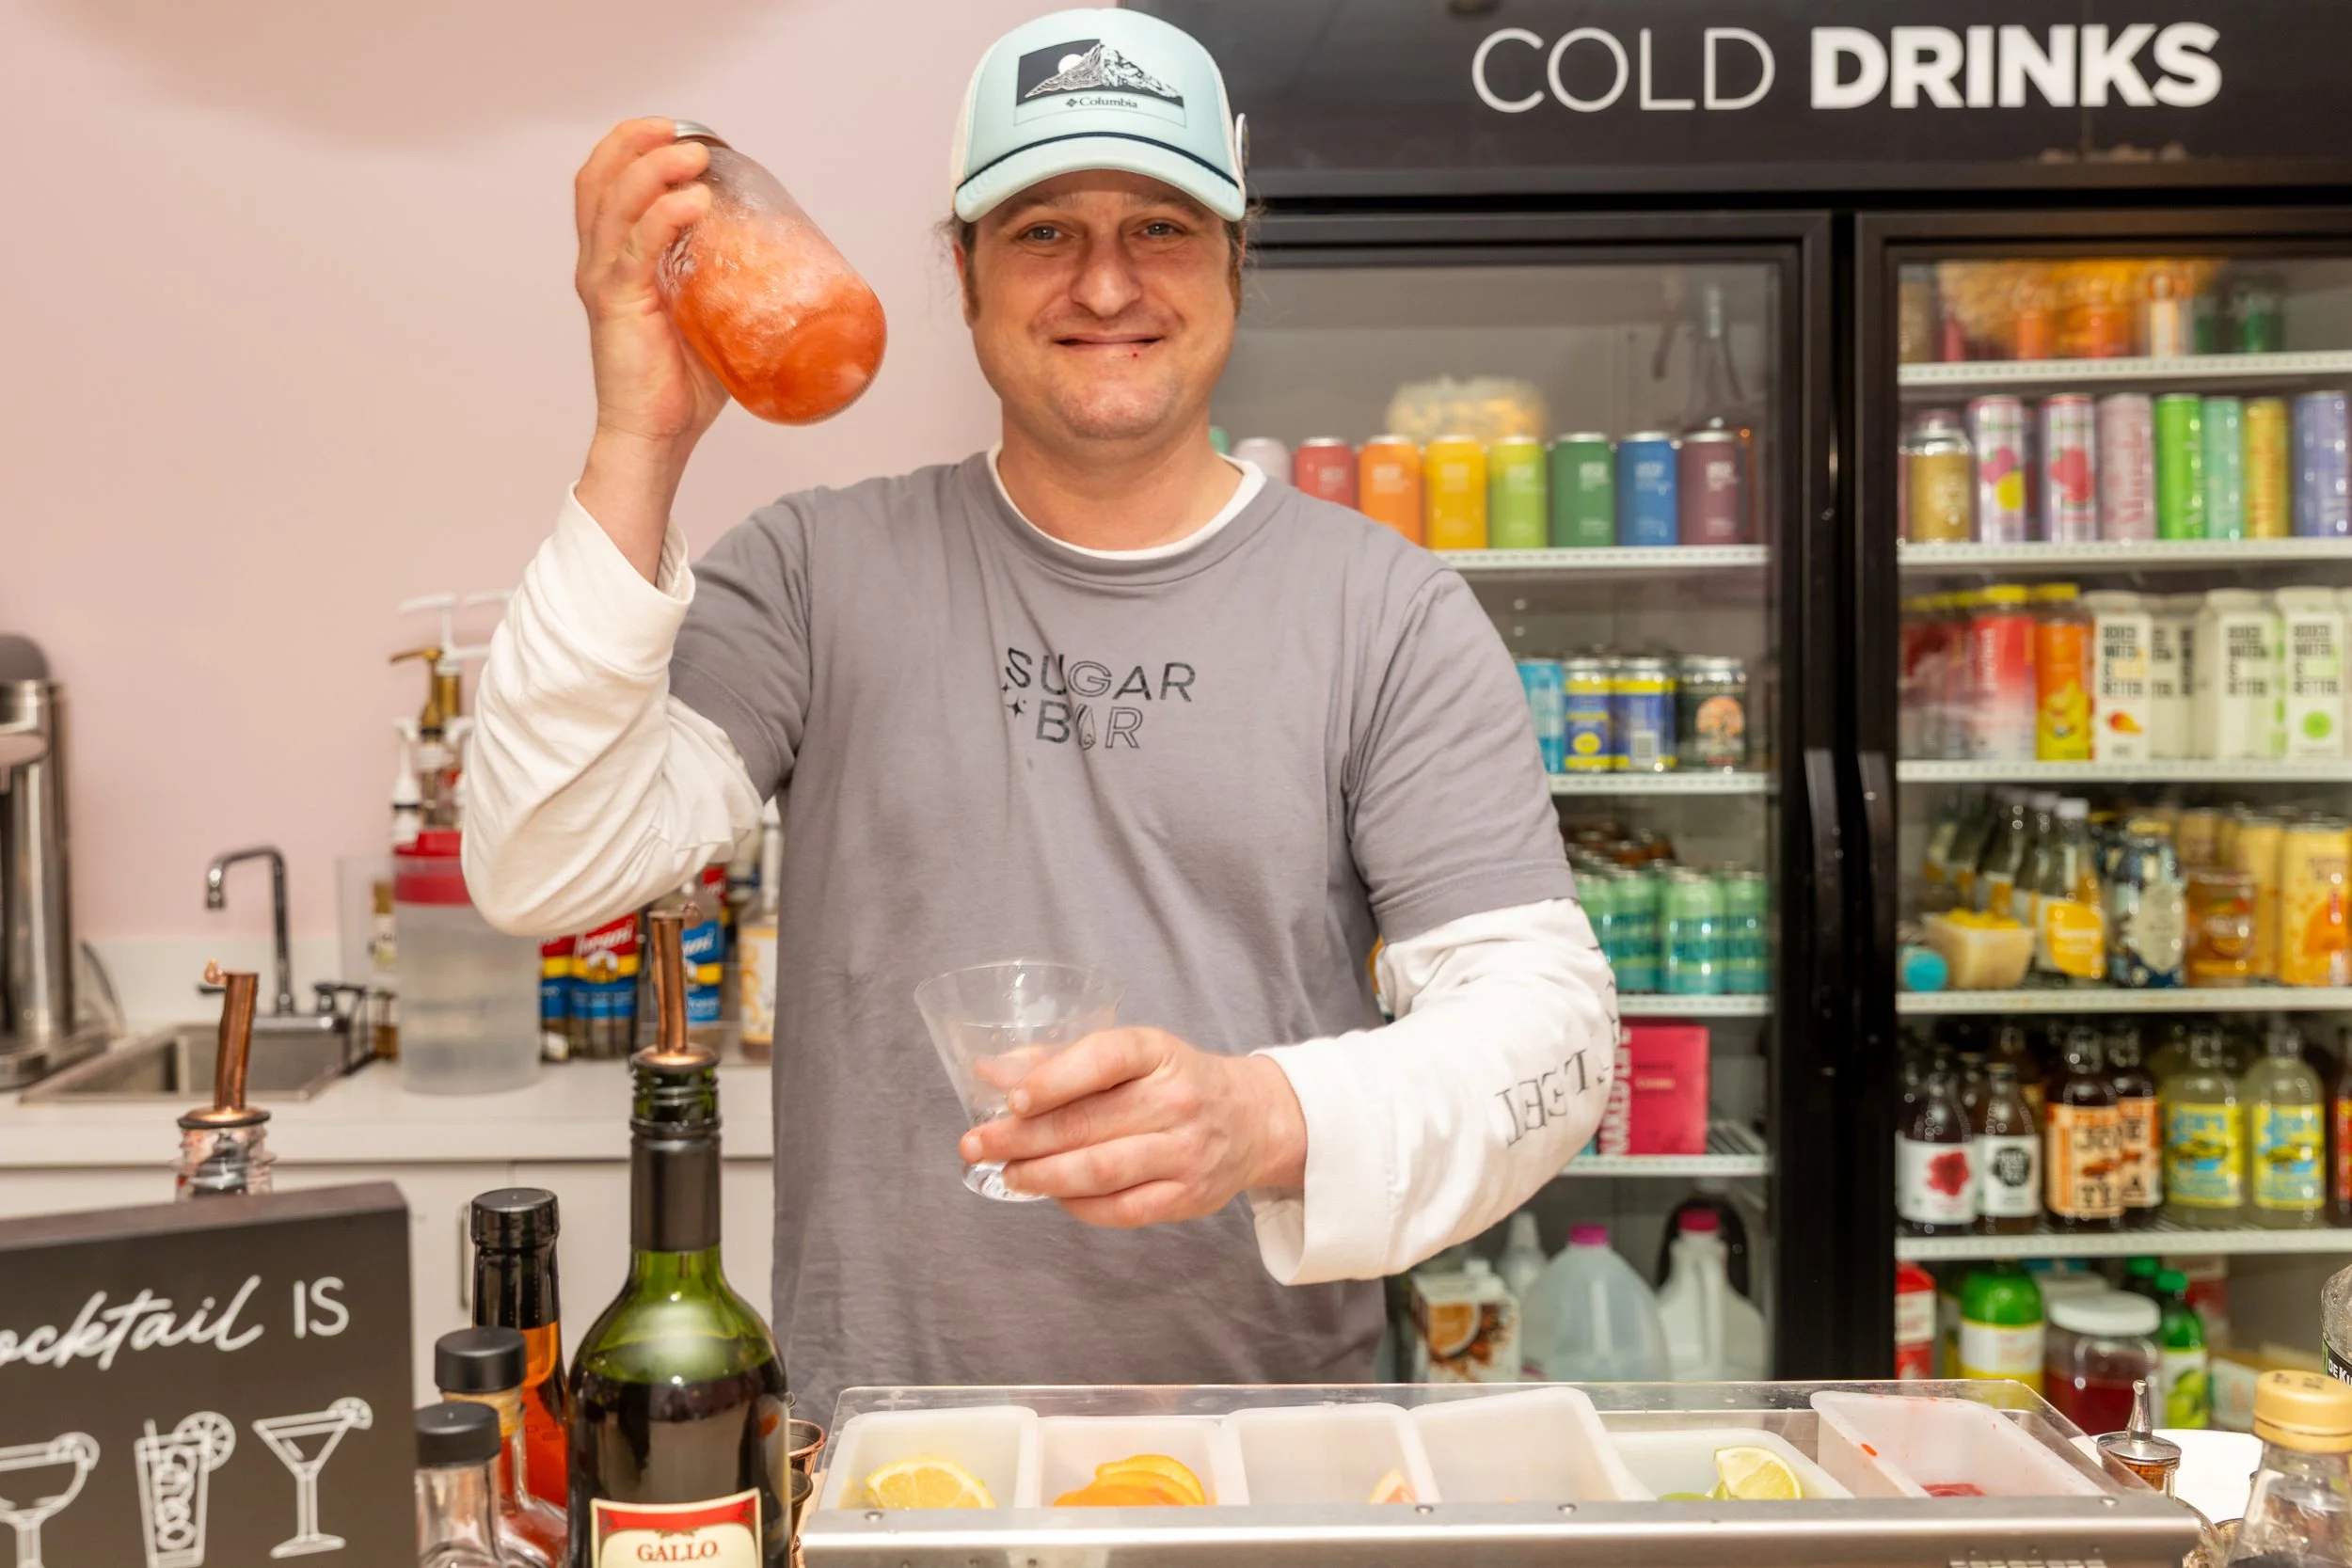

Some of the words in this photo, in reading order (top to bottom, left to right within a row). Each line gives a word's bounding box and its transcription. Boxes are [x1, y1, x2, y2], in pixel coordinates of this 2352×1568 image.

[1471, 26, 1776, 114] COLD
[1810, 21, 2223, 110] DRINKS
[1079, 96, 1138, 108] Columbia
[1005, 647, 1197, 702] SUGAR
[293, 1275, 350, 1338] IS
[637, 1540, 719, 1563] GALLO
